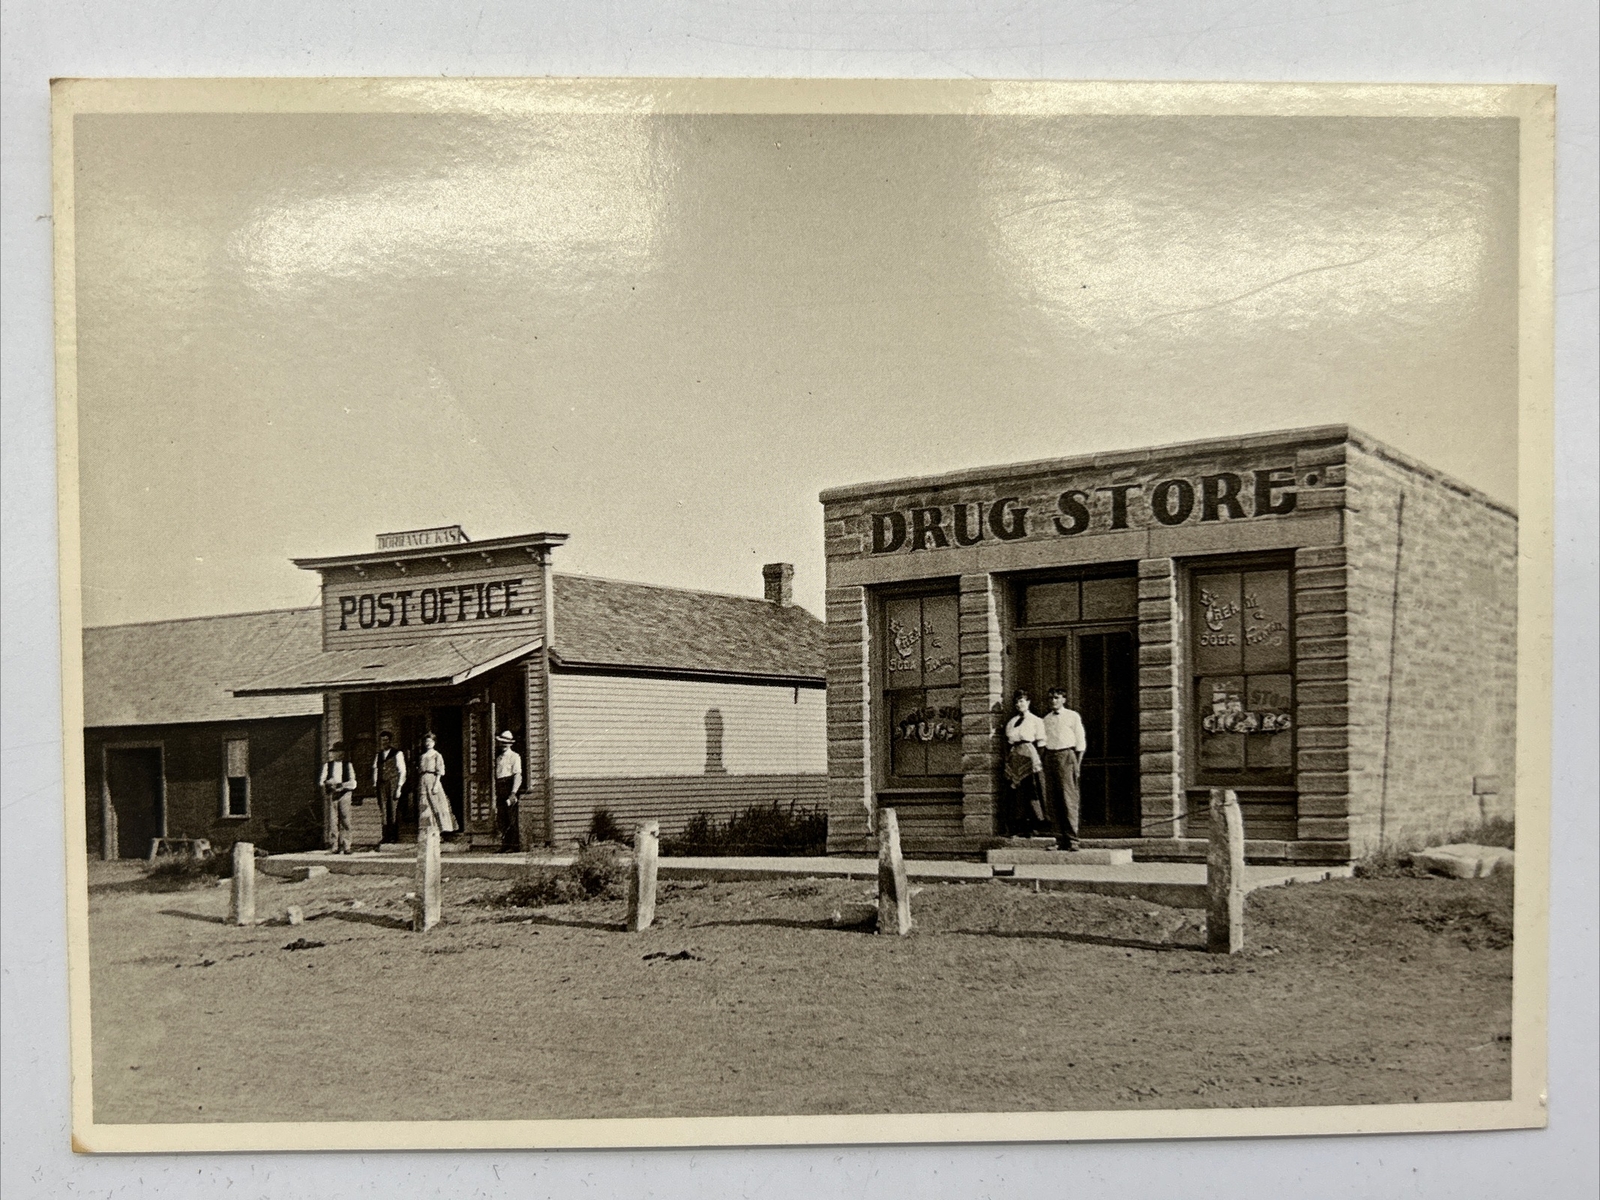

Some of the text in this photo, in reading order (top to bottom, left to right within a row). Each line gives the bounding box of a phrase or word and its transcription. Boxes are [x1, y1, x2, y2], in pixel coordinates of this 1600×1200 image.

[869, 466, 1298, 555] DRUG STORE
[339, 590, 414, 631] POST
[1202, 711, 1292, 734] CIGARS
